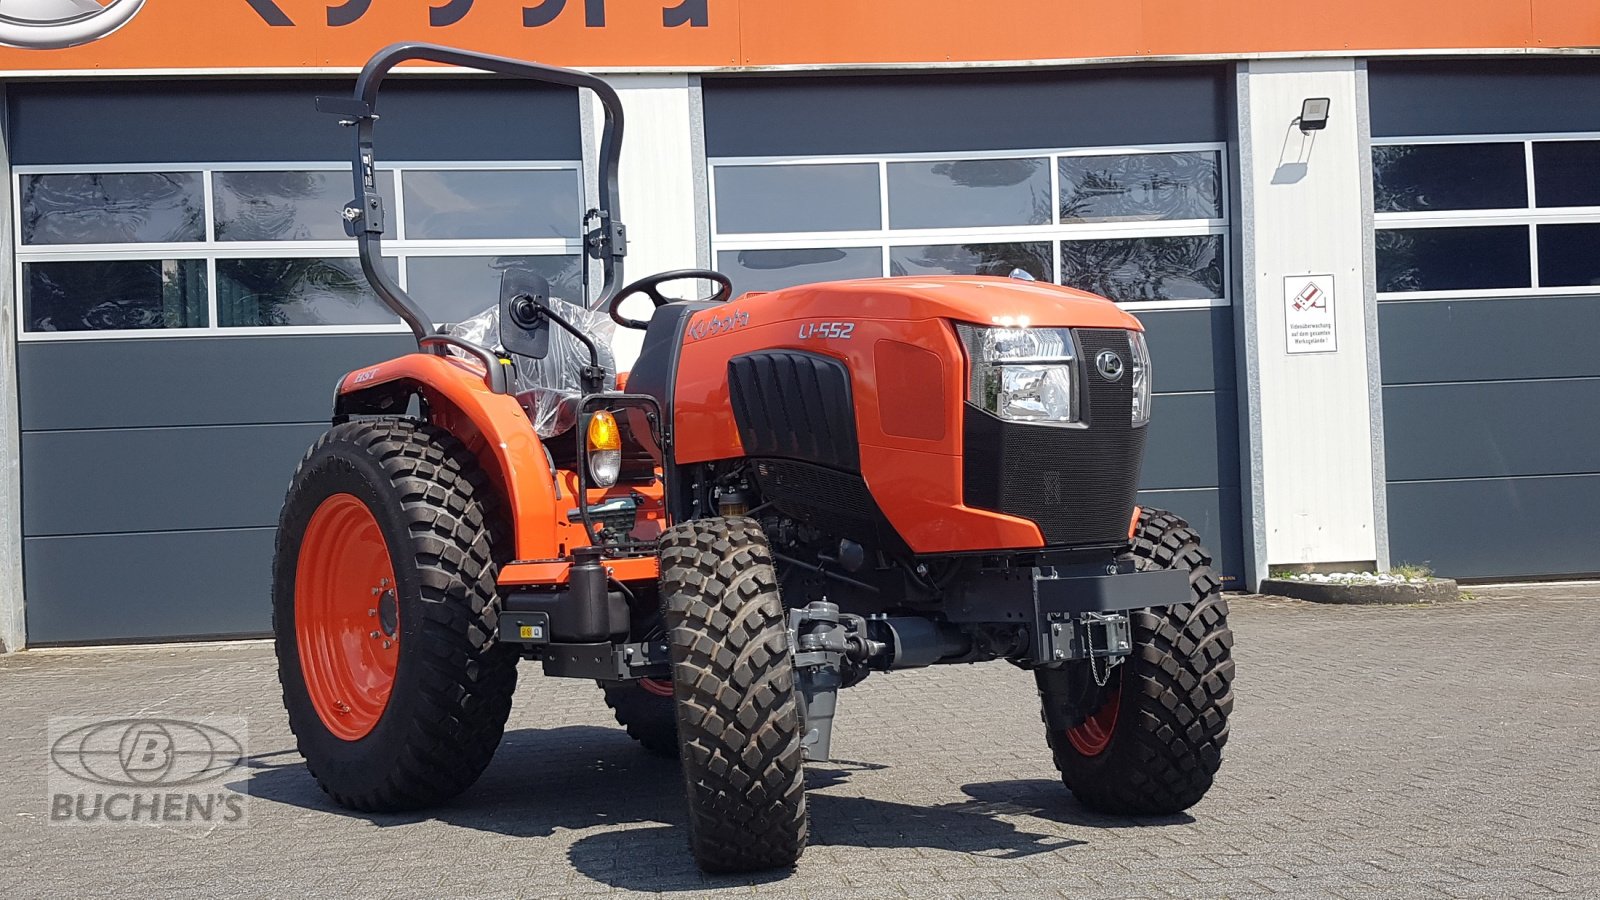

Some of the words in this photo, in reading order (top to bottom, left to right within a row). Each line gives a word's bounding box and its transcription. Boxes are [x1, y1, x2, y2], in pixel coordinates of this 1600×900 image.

[688, 309, 749, 340] Kubota
[799, 322, 855, 339] L1-552
[354, 368, 380, 384] HST
